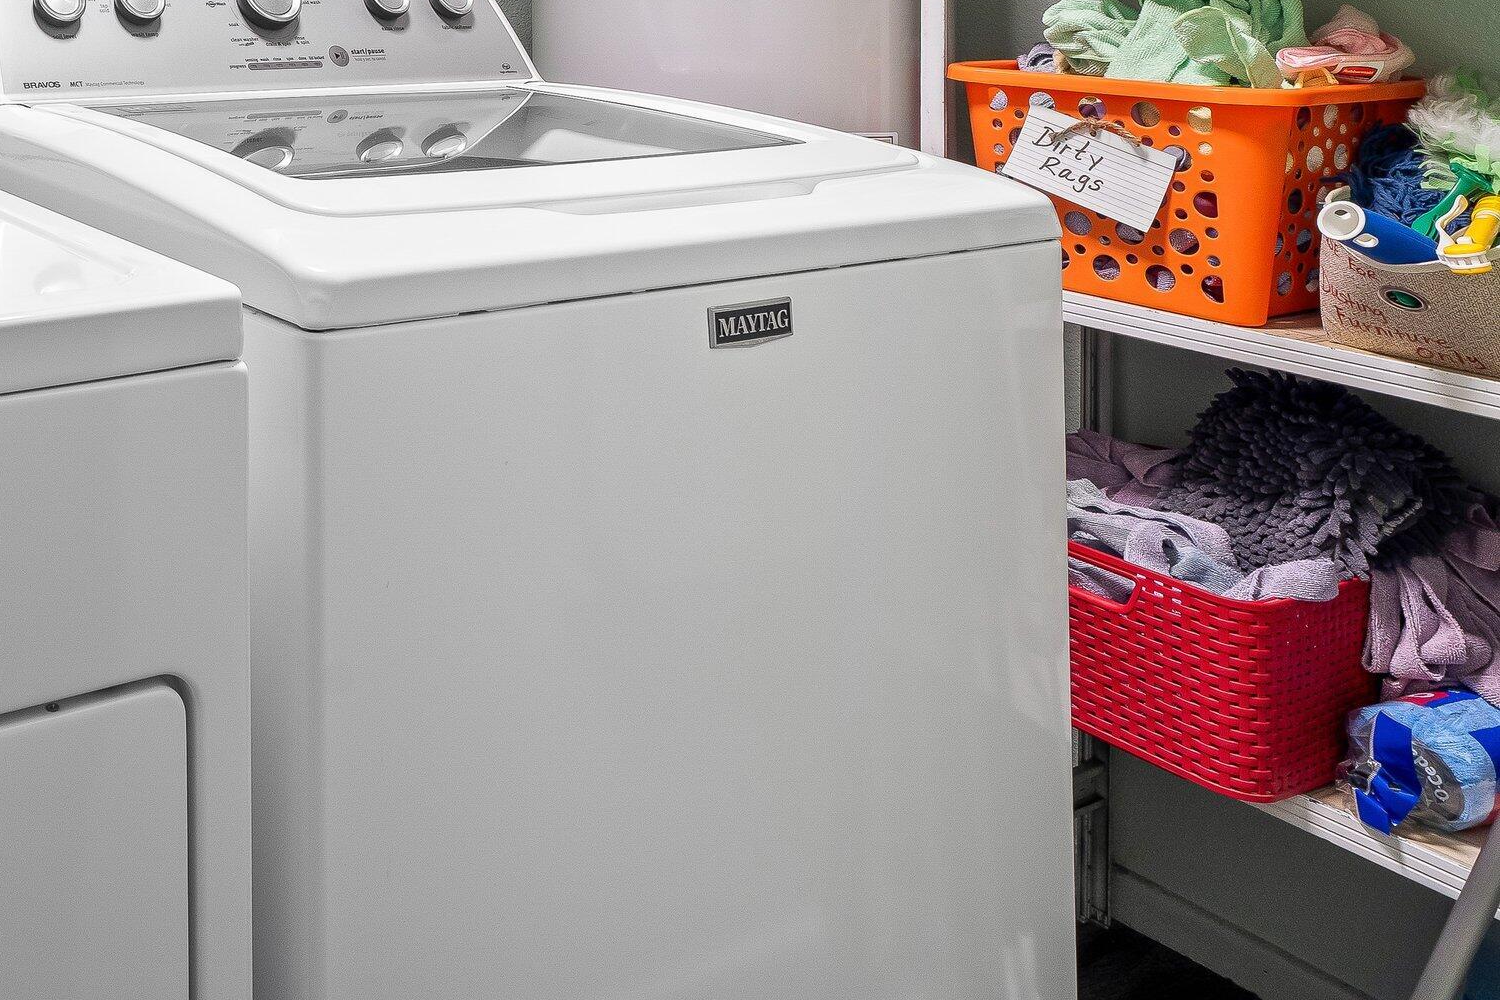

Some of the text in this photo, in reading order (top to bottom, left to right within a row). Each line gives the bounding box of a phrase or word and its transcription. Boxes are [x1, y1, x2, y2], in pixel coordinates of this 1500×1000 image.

[351, 47, 385, 56] start/pause
[23, 81, 61, 89] BRAVOS
[1032, 126, 1104, 171] Dirty
[1039, 156, 1104, 193] Rags
[718, 309, 789, 338] MAYTAG
